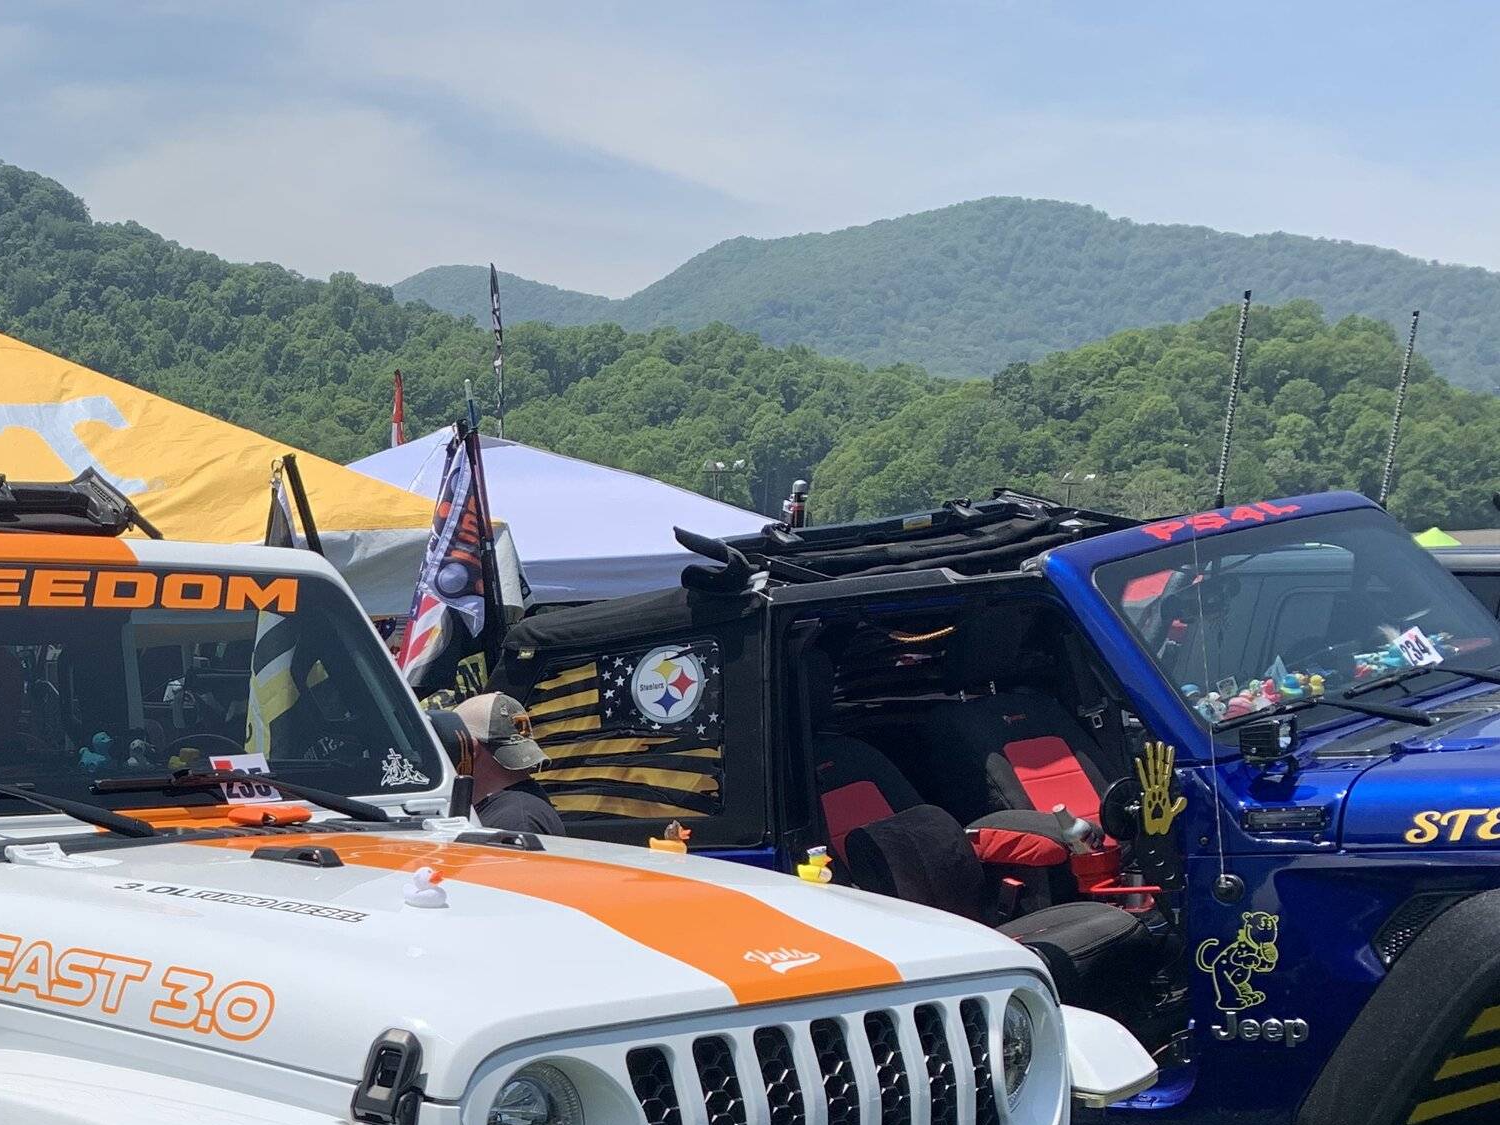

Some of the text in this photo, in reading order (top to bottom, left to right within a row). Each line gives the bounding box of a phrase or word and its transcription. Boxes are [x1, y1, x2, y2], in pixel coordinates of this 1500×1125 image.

[1400, 635, 1431, 665] 234
[150, 966, 275, 1042] 3.0
[1211, 1011, 1309, 1048] Jeep
